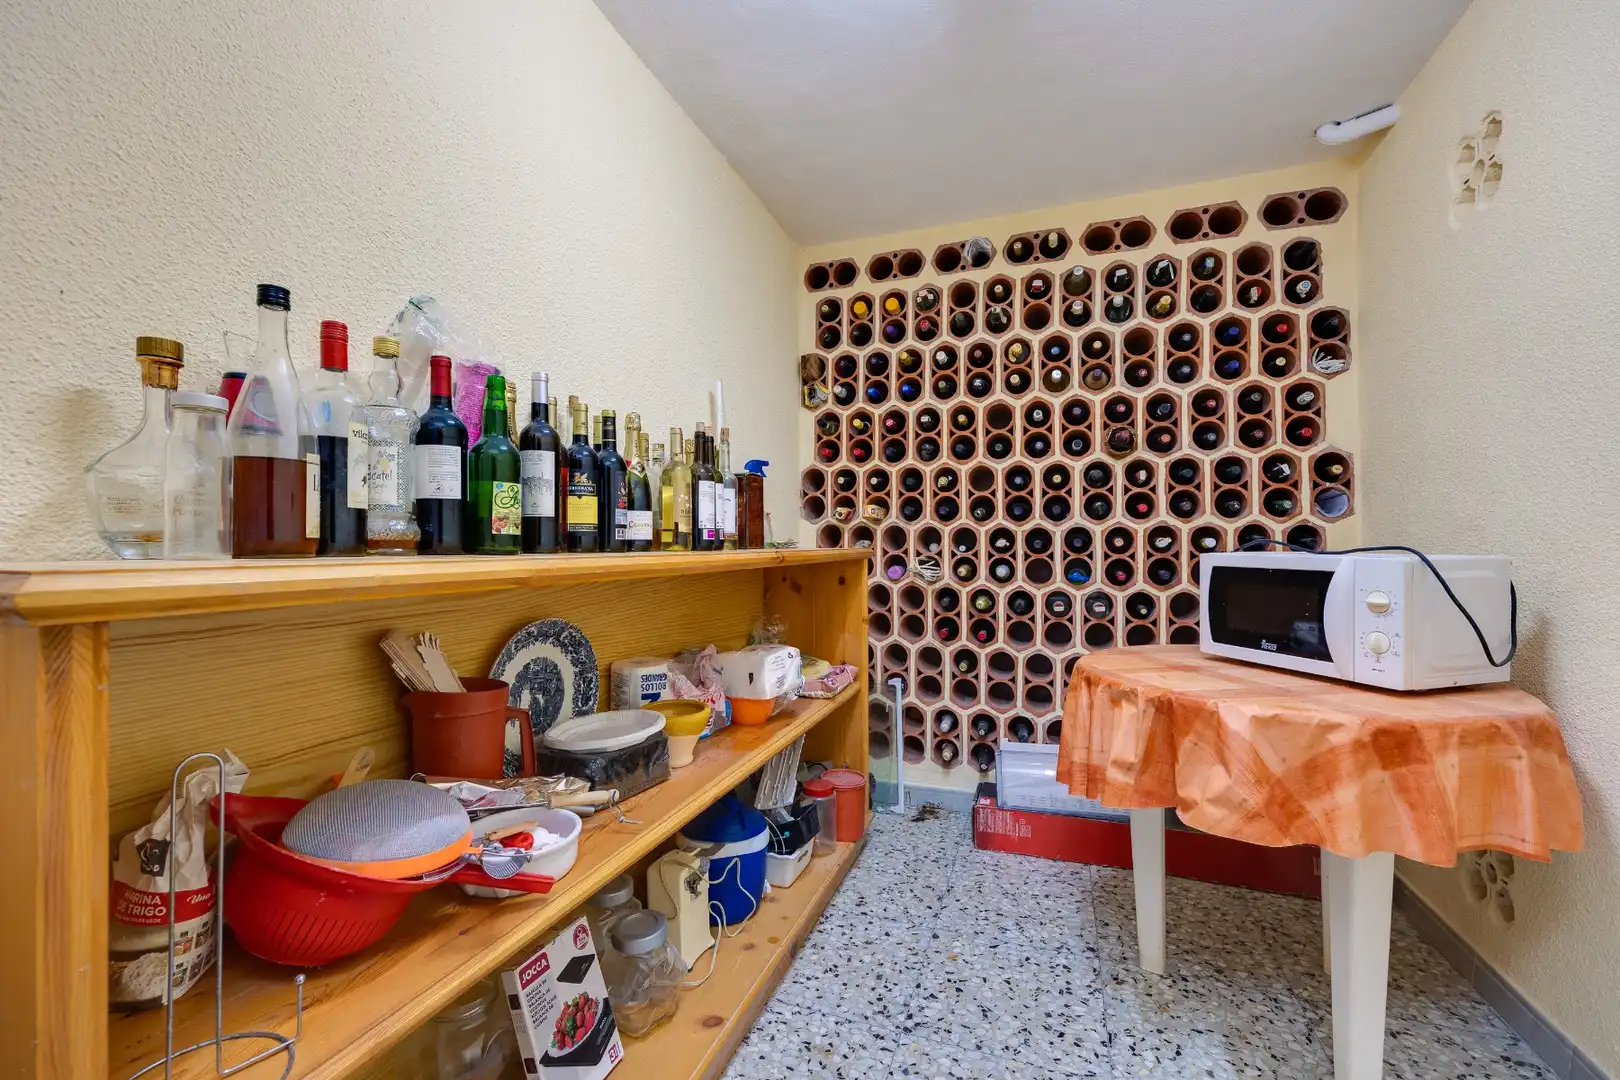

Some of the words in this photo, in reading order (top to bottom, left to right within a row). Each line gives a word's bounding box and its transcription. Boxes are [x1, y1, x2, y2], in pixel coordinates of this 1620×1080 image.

[368, 469, 392, 481] scatel
[640, 673, 667, 683] GRANDES
[640, 682, 666, 691] ROLLOS
[124, 890, 162, 905] HARINA
[127, 904, 167, 917] TRIGO
[522, 959, 548, 983] JOCCA
